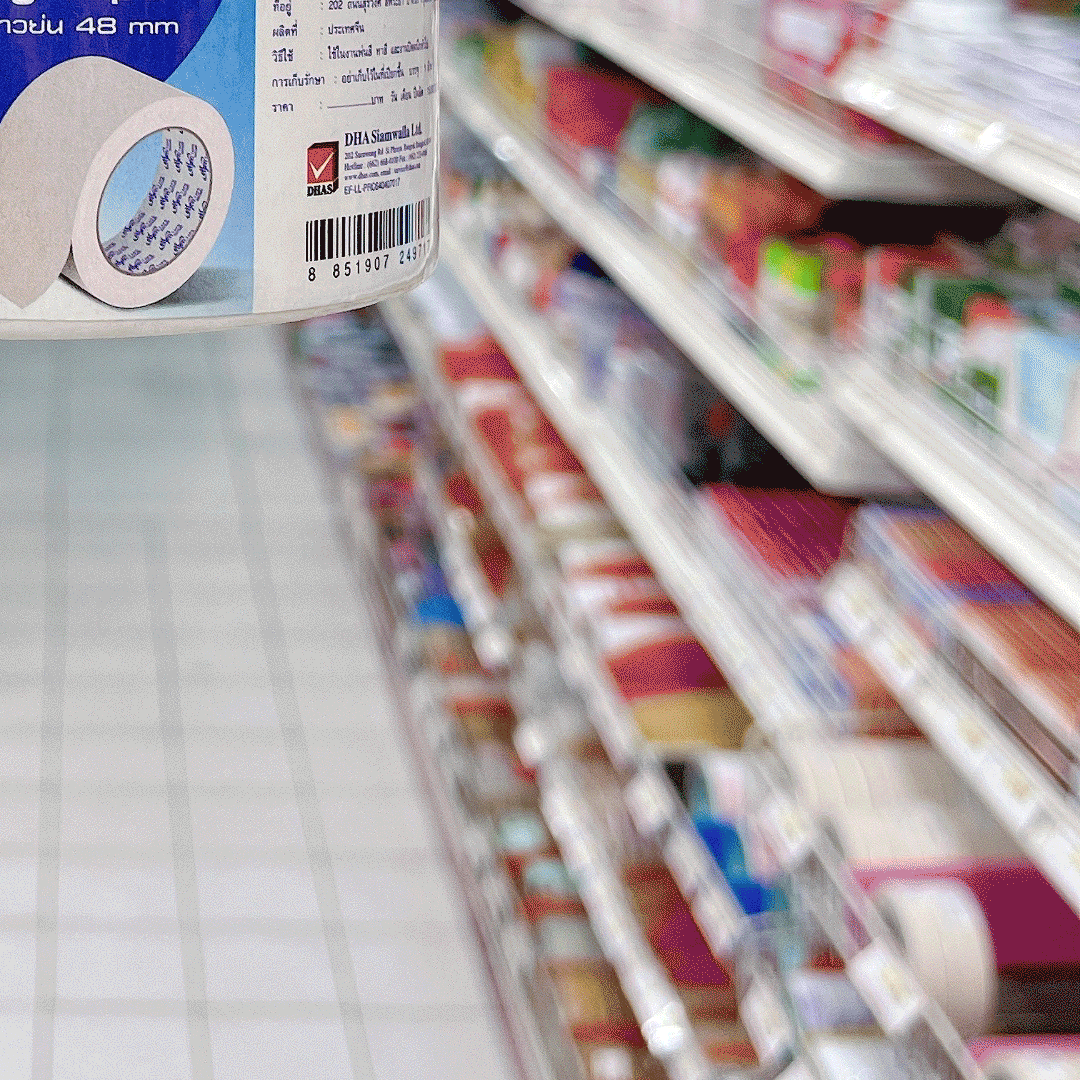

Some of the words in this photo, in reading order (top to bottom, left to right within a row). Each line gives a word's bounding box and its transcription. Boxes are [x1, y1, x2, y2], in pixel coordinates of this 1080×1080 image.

[328, 0, 344, 11] 202
[75, 16, 117, 35] 48
[128, 20, 179, 35] mm
[272, 19, 298, 38] ผลิตที่
[271, 47, 294, 63] วิธีใช้
[271, 72, 325, 88] การเก็บรักษา
[271, 102, 294, 113] ราคา
[344, 130, 370, 147] DHA
[370, 124, 410, 144] Siamwalla
[306, 183, 334, 198] DHAS
[307, 266, 317, 282] 8
[332, 254, 390, 279] 851907
